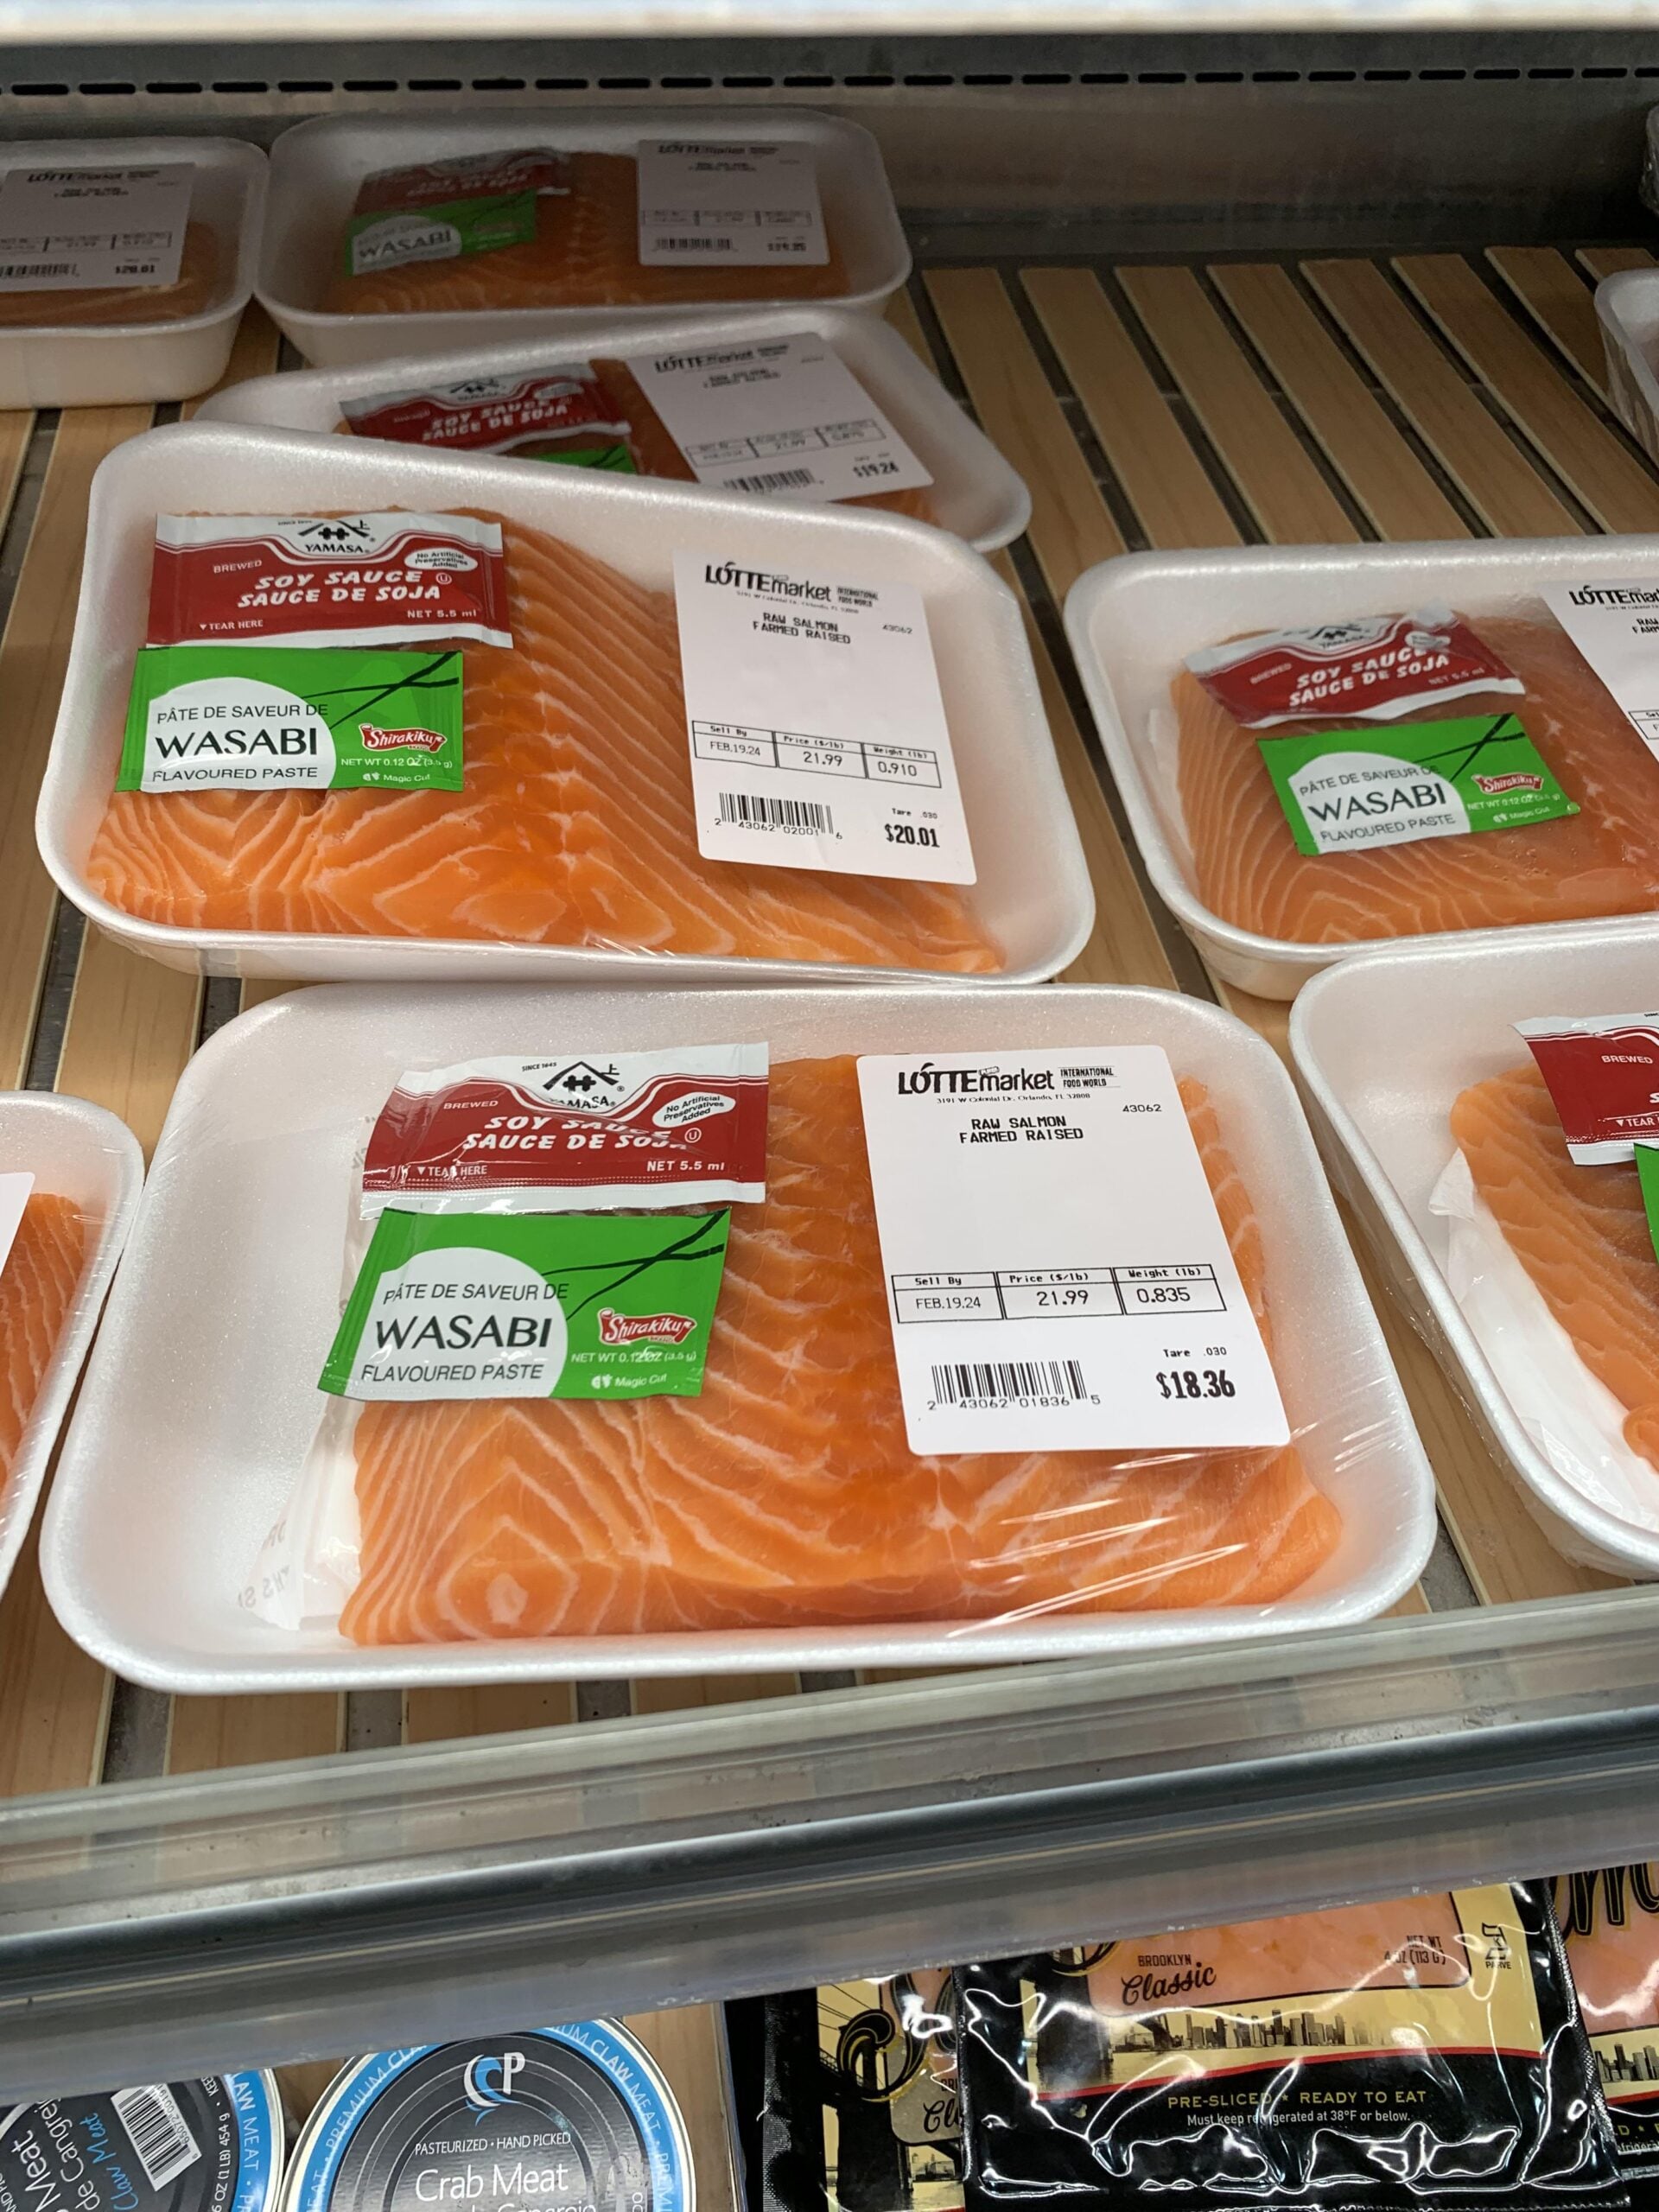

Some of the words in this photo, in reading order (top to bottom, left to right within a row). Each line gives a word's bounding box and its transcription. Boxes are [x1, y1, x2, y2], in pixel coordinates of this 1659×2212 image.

[359, 229, 452, 258] WASABI
[423, 420, 481, 442] SAUCE
[489, 413, 514, 429] DE
[521, 404, 568, 423] SOJA
[431, 410, 474, 429] SOY
[305, 543, 364, 554] YAMASA
[213, 561, 263, 574] BREWED
[254, 573, 315, 590] SOY
[324, 571, 423, 586] SAUCE
[238, 589, 321, 608] SAUCE
[331, 588, 367, 602] DE
[376, 586, 441, 601] SOJA
[407, 609, 432, 620] NET
[437, 609, 458, 619] 5.5
[461, 608, 477, 618] ml
[763, 612, 786, 625] RAW
[793, 617, 839, 632] SALMON
[209, 621, 236, 631] TEAR
[238, 620, 264, 629] HERE
[753, 620, 799, 637] FARMED
[805, 630, 851, 645] RAISED
[1288, 681, 1355, 708] SAUCE
[1362, 670, 1390, 685] DE
[1396, 654, 1450, 678] SOJA
[1296, 666, 1341, 690] SOY
[157, 707, 199, 725] PÂTE
[204, 706, 227, 719] DE
[232, 704, 302, 718] SAVEUR
[305, 703, 328, 716] DE
[368, 728, 437, 748] Shirakiku
[709, 725, 731, 734] Sell
[736, 728, 747, 738] By
[154, 728, 318, 760] WASABI
[784, 735, 809, 746] Price
[803, 751, 843, 767] 21.99
[873, 746, 903, 757] Weight
[341, 758, 362, 767] NET
[364, 758, 382, 767] WT
[384, 758, 404, 767] 0.12
[406, 758, 423, 767] OZ
[878, 761, 918, 777] 0.910
[152, 768, 257, 783] FLAVOURED
[262, 767, 318, 779] PASTE
[383, 773, 412, 783] Magic
[414, 772, 430, 783] Cut
[1299, 779, 1337, 797] PÂTE
[1338, 772, 1361, 785] DE
[1363, 766, 1418, 783] SAVEUR
[1420, 765, 1441, 776] DE
[1307, 783, 1448, 823] WASABI
[1467, 801, 1485, 811] NET
[1485, 799, 1502, 809] WT
[891, 807, 912, 817] Tare
[738, 820, 776, 832] 43062
[1319, 819, 1407, 842] FLAVOURED
[1408, 812, 1456, 829] PASTE
[884, 823, 940, 848] $20.01
[522, 1064, 540, 1072] SINCE
[1601, 1055, 1653, 1064] BREWED
[1060, 1068, 1114, 1078] INTERNATIONAL
[1063, 1078, 1081, 1089] FOOD
[1083, 1077, 1107, 1088] WORLD
[443, 1100, 499, 1110] BREWED
[664, 1102, 725, 1122] Preservatives
[666, 1104, 679, 1114] No
[681, 1096, 721, 1109] Artificial
[1122, 1103, 1162, 1113] 43062
[485, 1116, 552, 1130] SOY
[681, 1108, 710, 1123] Added
[971, 1118, 1001, 1130] RAW
[1008, 1116, 1067, 1128] SALMON
[1626, 1117, 1655, 1127] TEAR
[462, 1133, 555, 1150] SAUCE
[566, 1135, 607, 1150] DE
[960, 1129, 1018, 1144] FARMED
[1027, 1128, 1084, 1141] RAISED
[460, 1164, 487, 1176] HERE
[646, 1160, 675, 1172] NET
[679, 1160, 702, 1171] 5.5
[707, 1160, 725, 1171] ml
[915, 1276, 944, 1287] Sell
[947, 1276, 963, 1287] By
[1009, 1274, 1044, 1284] Price
[1049, 1272, 1089, 1283] ($/lb)
[1128, 1268, 1170, 1280] Weight
[1175, 1267, 1202, 1278] (lb)
[383, 1284, 429, 1306] PÂTE
[431, 1284, 459, 1299] DE
[463, 1284, 537, 1301] SAVEUR
[543, 1283, 569, 1300] DE
[915, 1296, 982, 1310] FEB.19.24
[1035, 1289, 1089, 1307] 21.99
[1135, 1287, 1192, 1305] 0.835
[375, 1314, 553, 1350] WASABI
[605, 1315, 685, 1342] Shirakiku
[571, 1352, 595, 1363] NET
[598, 1352, 618, 1363] WT
[1162, 1347, 1191, 1358] Tare
[1202, 1345, 1228, 1357] .030
[361, 1364, 476, 1382] FLAVOURED
[480, 1364, 545, 1380] PASTE
[614, 1376, 647, 1389] Magic
[649, 1374, 667, 1384] Cut
[1155, 1368, 1236, 1401] $18.36
[927, 1400, 938, 1411] 2
[958, 1395, 1008, 1409] 43062
[1018, 1395, 1071, 1408] 01836
[1090, 1393, 1101, 1406] 5
[1428, 1936, 1442, 1948] WT
[1137, 1954, 1192, 1967] BROOKLYN
[1121, 1961, 1217, 2005] Classic
[590, 2038, 634, 2083] CLAW
[629, 2082, 662, 2132] MEAT
[325, 2066, 387, 2149] PREMIUM
[1167, 2093, 1273, 2109] PRE-SLICED
[1300, 2092, 1357, 2104] READY
[1364, 2092, 1388, 2103] TO
[1395, 2090, 1427, 2103] EAT
[1187, 2113, 1216, 2126] Must
[1217, 2113, 1244, 2126] keep
[1316, 2112, 1328, 2121] at
[1330, 2110, 1357, 2121] 38°F
[1360, 2111, 1372, 2121] or
[1375, 2109, 1411, 2121] below.
[79, 2113, 117, 2164] Meat
[219, 2125, 231, 2147] 454
[242, 2116, 260, 2171] MEAT
[415, 2138, 488, 2156] PASTEURIZED
[496, 2135, 531, 2150] HAND
[532, 2131, 572, 2146] PICKED
[219, 2149, 232, 2169] LB)
[105, 2166, 139, 2210] Claw
[415, 2164, 485, 2202] Crab
[493, 2161, 569, 2197] Meat
[74, 2180, 101, 2211] de
[213, 2183, 229, 2202] OZ
